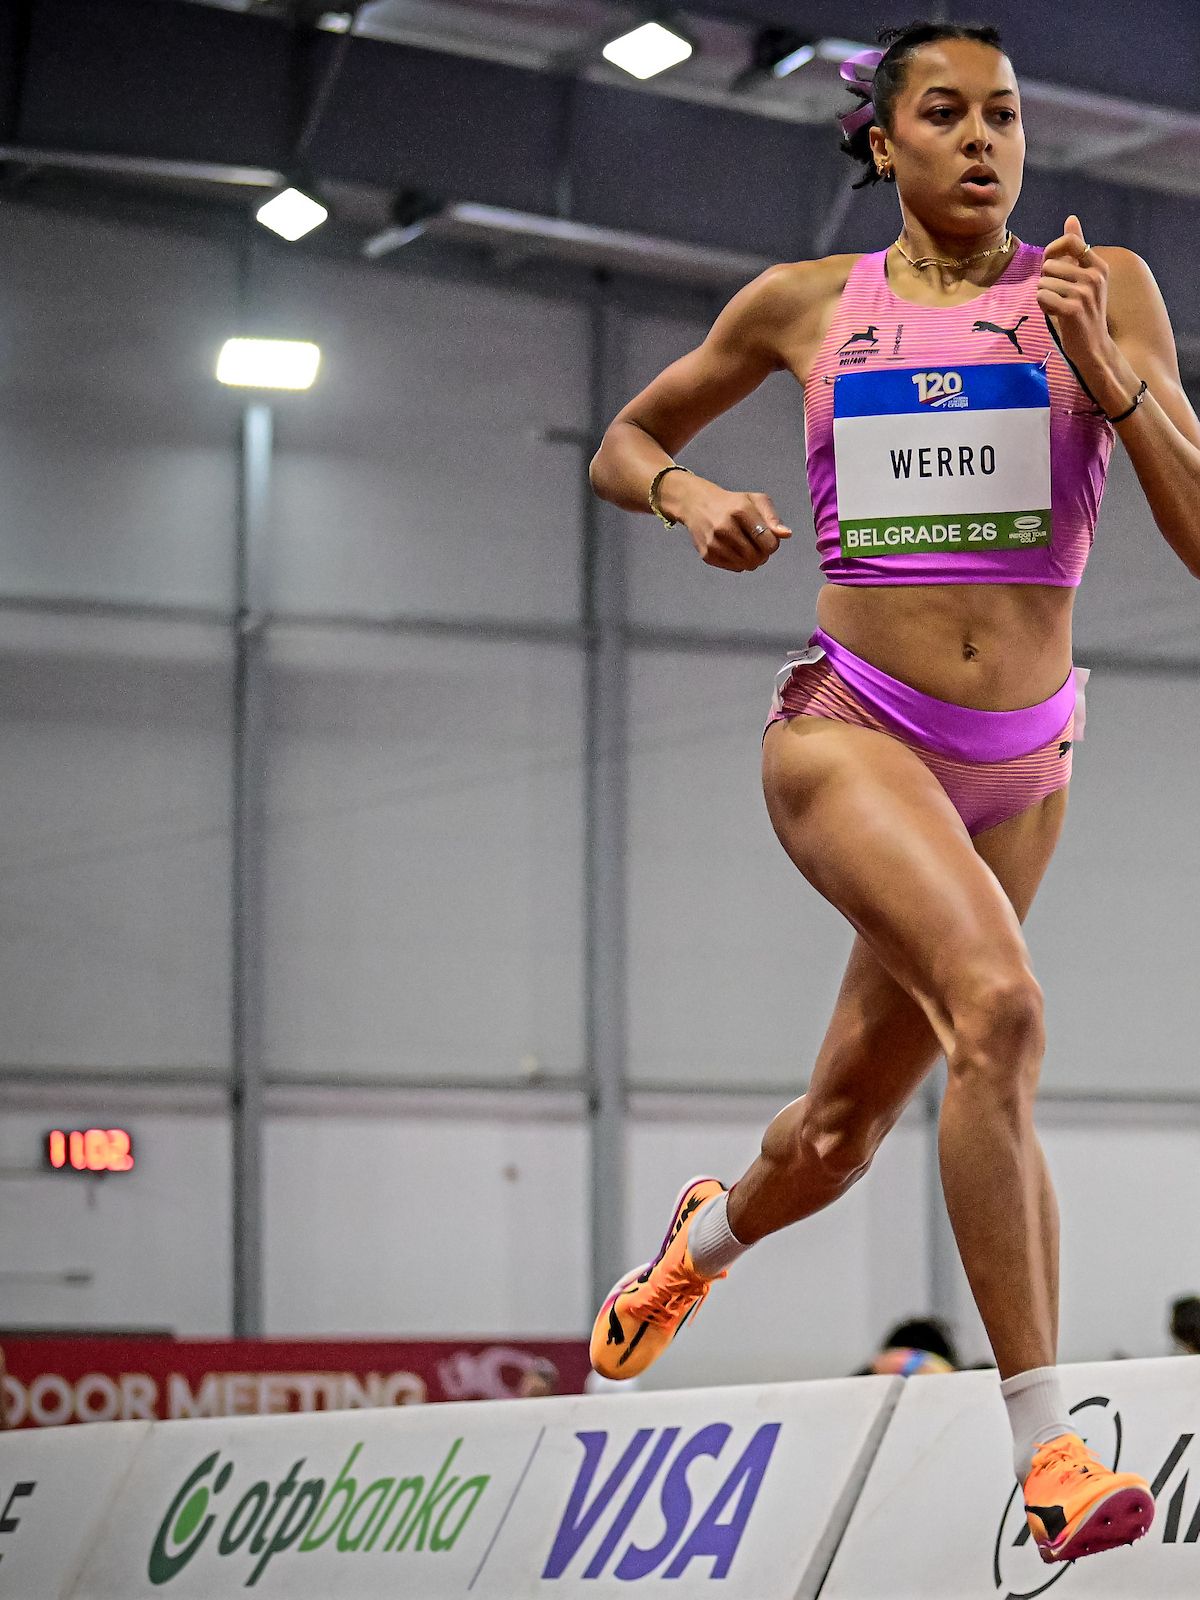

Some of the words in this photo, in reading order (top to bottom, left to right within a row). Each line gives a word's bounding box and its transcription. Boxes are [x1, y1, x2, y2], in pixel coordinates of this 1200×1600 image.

[911, 371, 963, 403] 120
[890, 445, 996, 479] WERRO
[846, 524, 961, 548] BELGRADE
[967, 522, 997, 541] 26
[166, 1371, 427, 1420] MEETING
[541, 1422, 783, 1581] VISA
